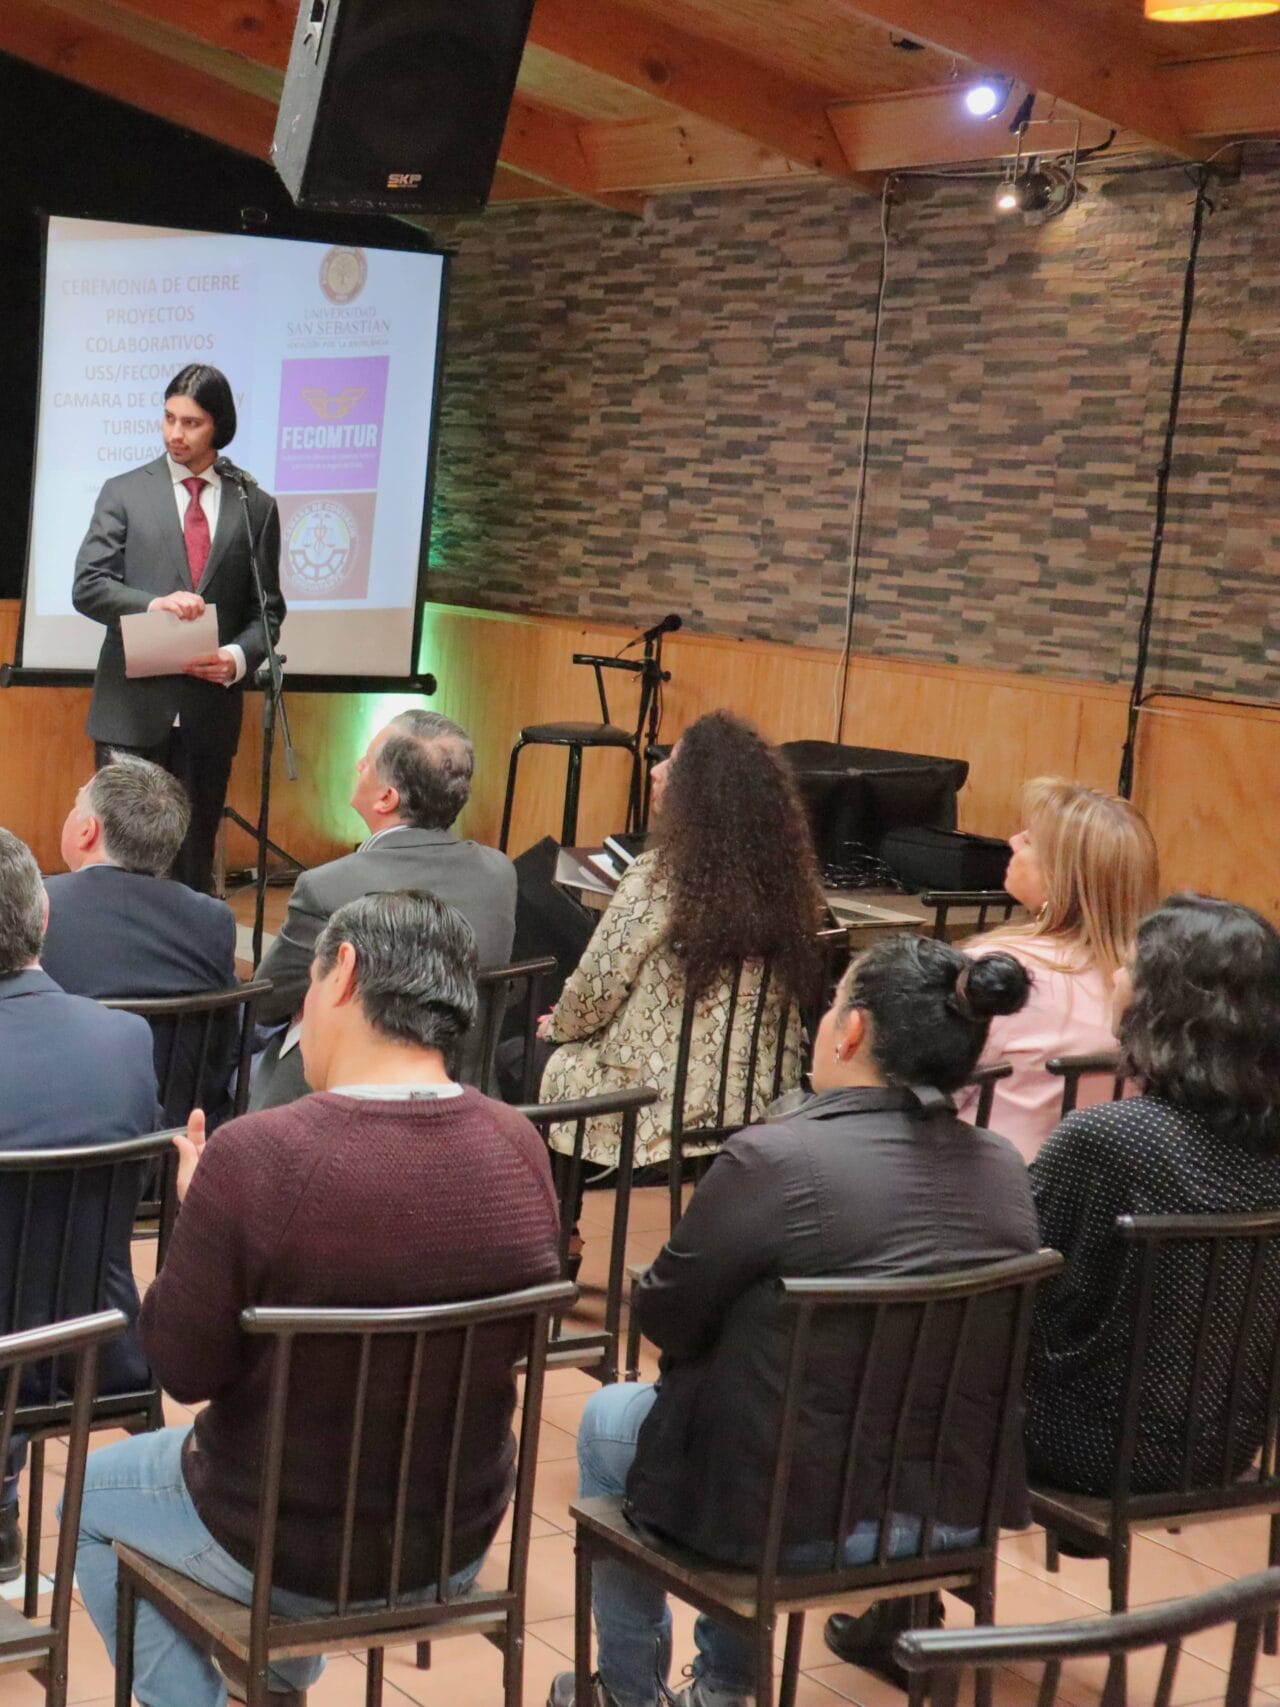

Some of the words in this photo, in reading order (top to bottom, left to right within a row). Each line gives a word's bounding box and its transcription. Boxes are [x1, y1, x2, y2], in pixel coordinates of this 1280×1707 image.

[389, 174, 422, 184] SKP
[61, 278, 157, 296] CEREMONIA
[162, 277, 181, 294] DE
[187, 273, 240, 293] CIERRE
[106, 304, 195, 324] PROYECTOS
[86, 333, 214, 354] COLABORATIVOS
[53, 392, 123, 409] CAMARA
[127, 392, 145, 408] DE
[103, 418, 163, 436] TURISM
[281, 424, 378, 450] FECOMTUR
[97, 445, 161, 462] CHIGUAY
